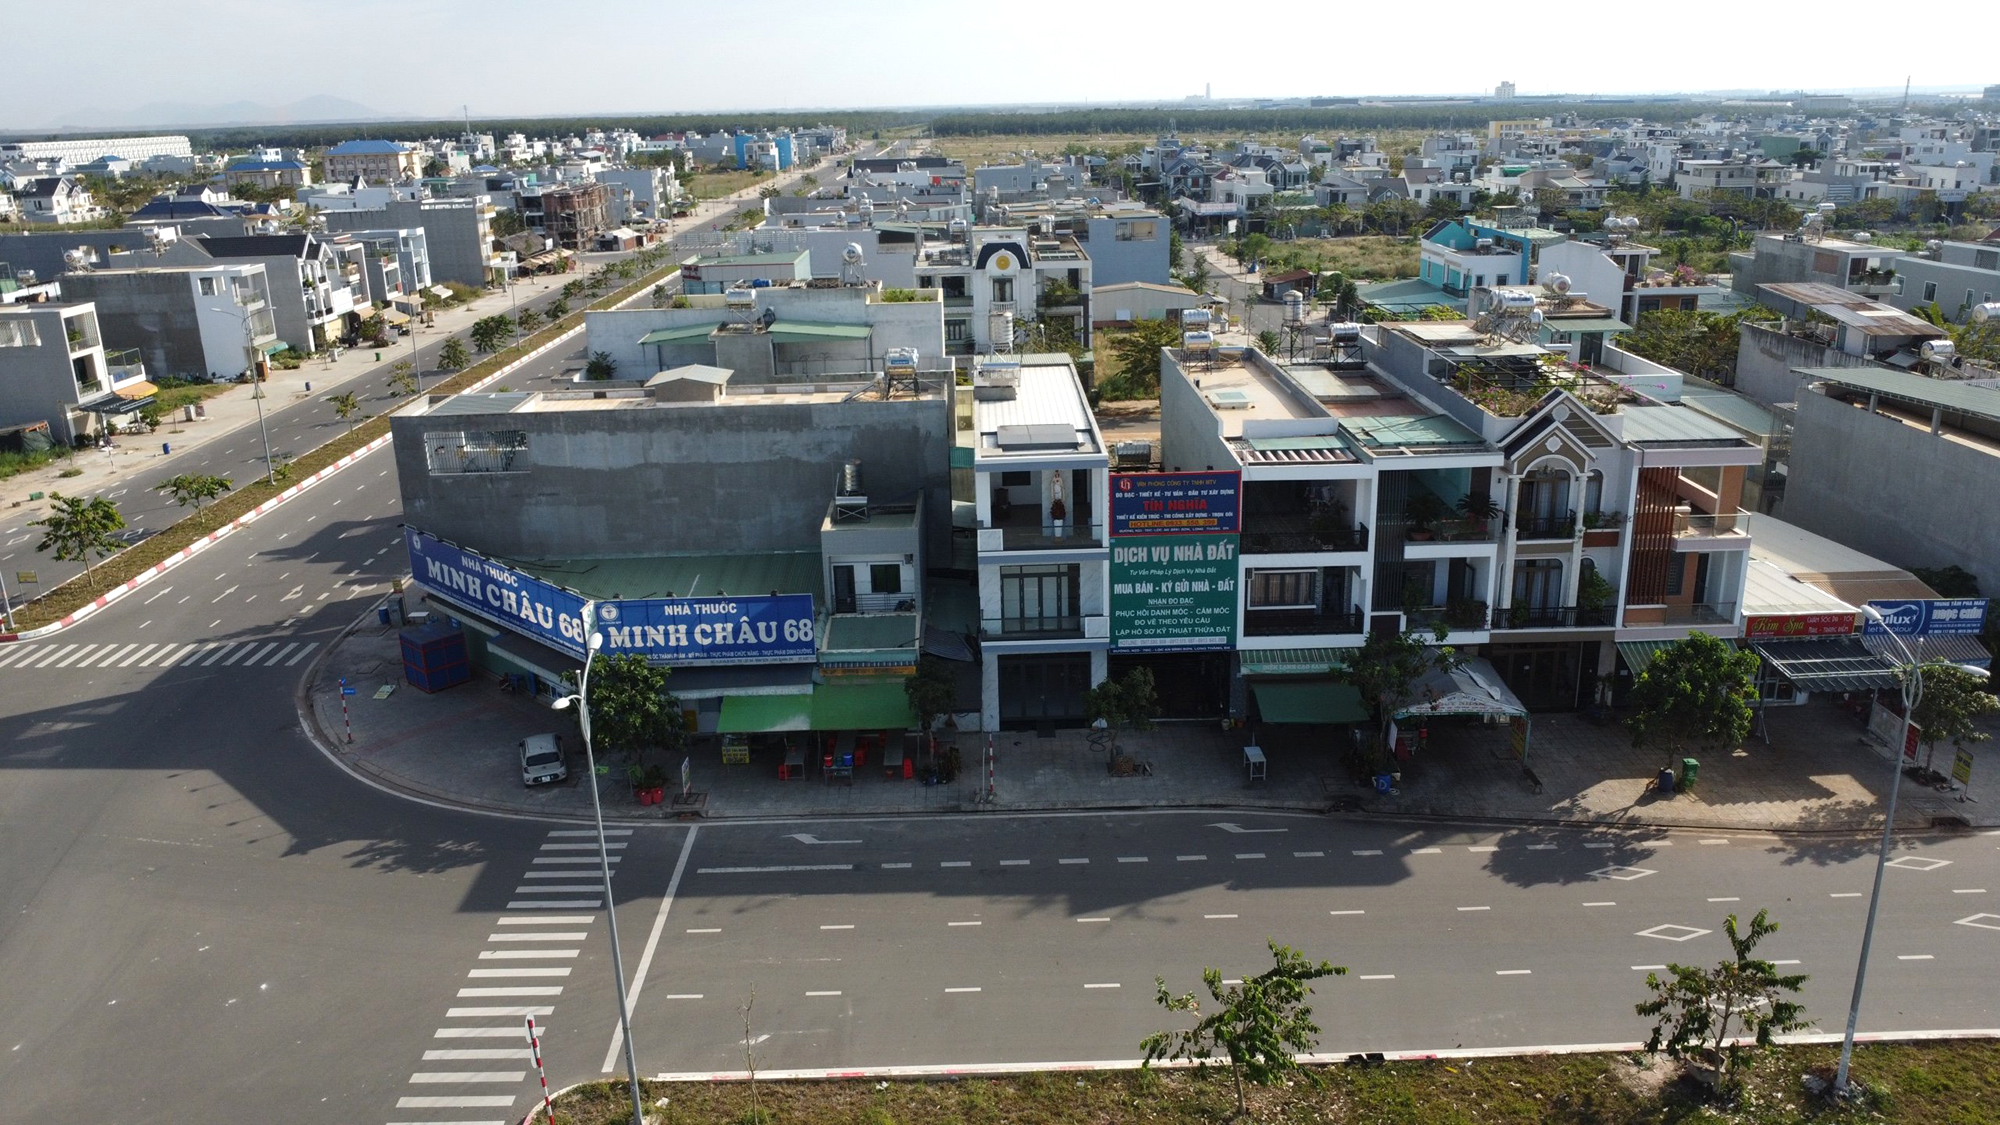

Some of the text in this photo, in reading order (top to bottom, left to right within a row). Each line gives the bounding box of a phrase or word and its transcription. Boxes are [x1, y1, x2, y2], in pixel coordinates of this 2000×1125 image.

[1143, 498, 1208, 511] TÍN NGHĨA
[1114, 539, 1234, 566] DỊCH VỤ NHÀ ĐẤT
[461, 555, 518, 588] NHÀ THUỐC
[1150, 568, 1164, 576] Pháp
[1165, 568, 1172, 576] Lý
[1172, 568, 1185, 576] Dịch
[1114, 576, 1235, 594] MUA BÁN KÝ GỬI NHÀ ĐẤT
[426, 557, 483, 600] MINH
[486, 590, 553, 629] CHÂU
[558, 613, 585, 644] 68
[1148, 598, 1167, 606] NHẬN
[1179, 597, 1194, 606] ĐẠC
[664, 601, 737, 616] NHÀ THUỐC
[1115, 610, 1135, 618] PHỤC
[1136, 608, 1149, 616] HỒI
[1172, 607, 1189, 615] MỐC
[1196, 607, 1212, 615] CẮM
[1213, 606, 1230, 614] MỐC
[1931, 609, 1959, 621] NGỌC
[1194, 616, 1211, 624] CẦU
[1752, 616, 1805, 634] Kim Spa
[608, 616, 813, 648] MINH CHÂU 68
[1115, 628, 1130, 636] LẬP
[1131, 627, 1142, 635] HỒ
[1156, 626, 1167, 634] KỸ
[1168, 626, 1193, 635] THUẬT
[1194, 625, 1215, 633] THỬA
[1216, 625, 1231, 633] ĐẤT
